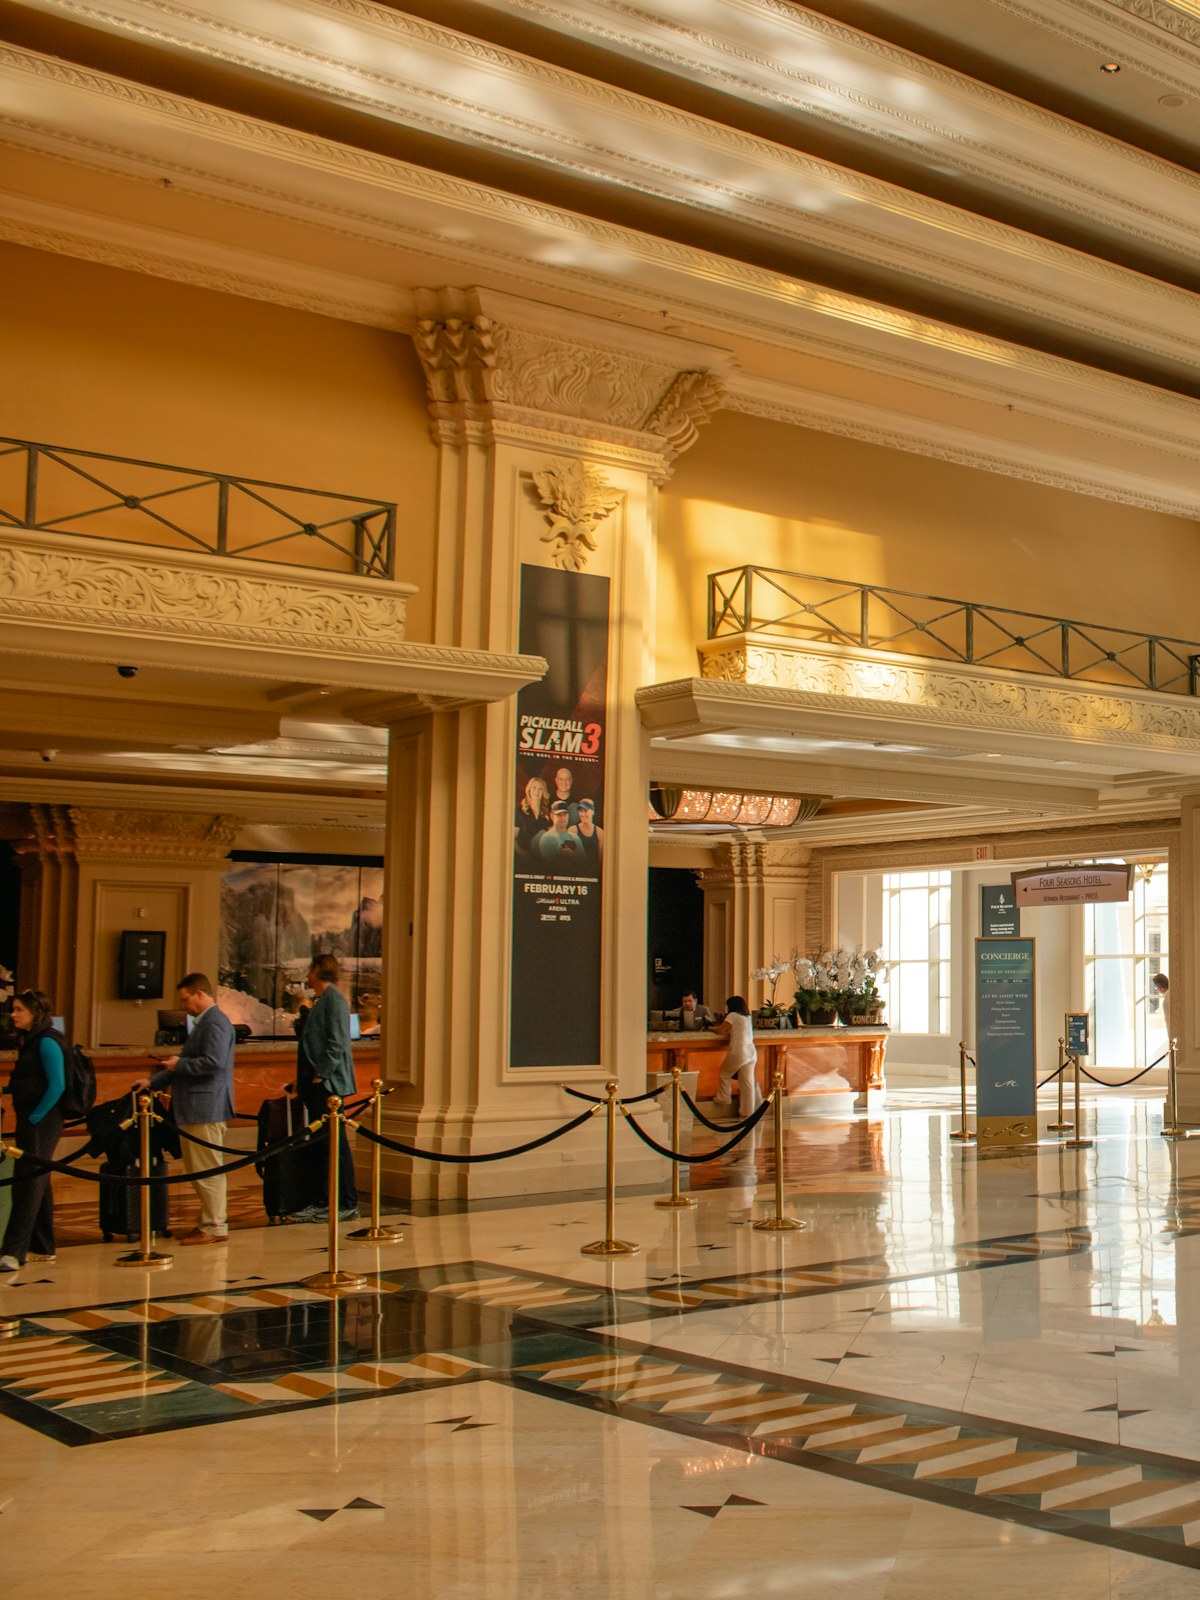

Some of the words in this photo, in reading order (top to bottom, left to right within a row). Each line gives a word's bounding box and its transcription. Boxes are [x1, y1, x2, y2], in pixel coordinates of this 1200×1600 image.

[520, 715, 583, 732] PICKLEBALL
[519, 727, 583, 753] SLAM
[581, 723, 602, 754] 3
[976, 847, 987, 860] EXIT
[1040, 877, 1055, 887] FOUR
[1056, 876, 1082, 887] SEASONS
[1083, 875, 1102, 885] HOTEL
[524, 883, 576, 895] FEBRUARY
[577, 886, 588, 895] 16
[1085, 892, 1099, 900] PRESS
[981, 952, 1030, 960] CONCIERGE
